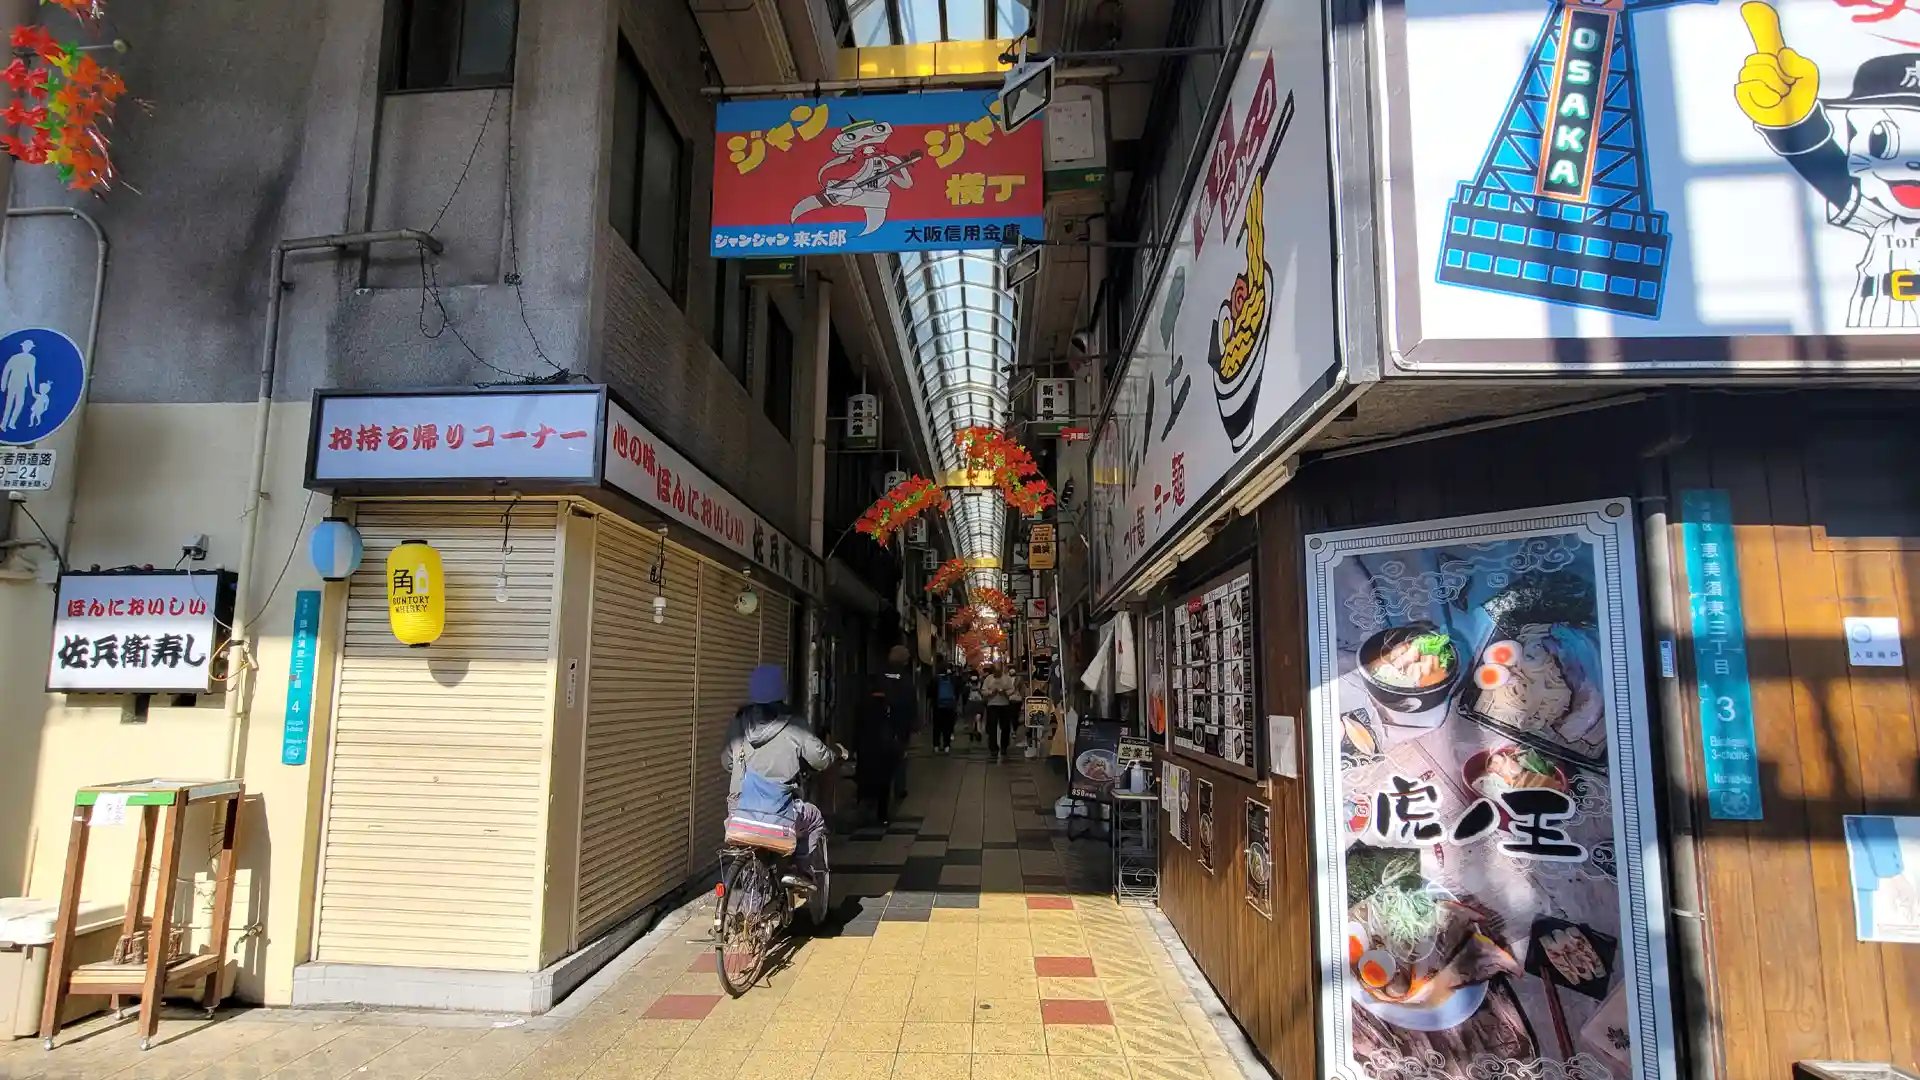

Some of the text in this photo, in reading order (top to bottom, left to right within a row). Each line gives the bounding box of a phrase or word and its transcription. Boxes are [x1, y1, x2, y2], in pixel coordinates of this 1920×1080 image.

[1550, 27, 1597, 188] OSAKA
[727, 103, 829, 175] ジャン
[924, 99, 1004, 169] ジャ
[946, 173, 1026, 206] 横丁
[715, 229, 847, 249] ジャンジャン 来太郎
[904, 223, 1022, 245] 大阪信用金庫
[328, 423, 588, 451] お持ち帰りコーナー
[0, 453, 52, 466] 者用道路
[613, 421, 656, 477] 心の味
[656, 463, 744, 547] ほんにおいしい
[393, 569, 413, 596] 角
[67, 599, 207, 617] ほんにおいしい
[393, 595, 430, 606] SUNTORY
[57, 633, 207, 670] 佐兵衛寿し
[292, 700, 301, 713] 4
[1718, 697, 1736, 722] 3
